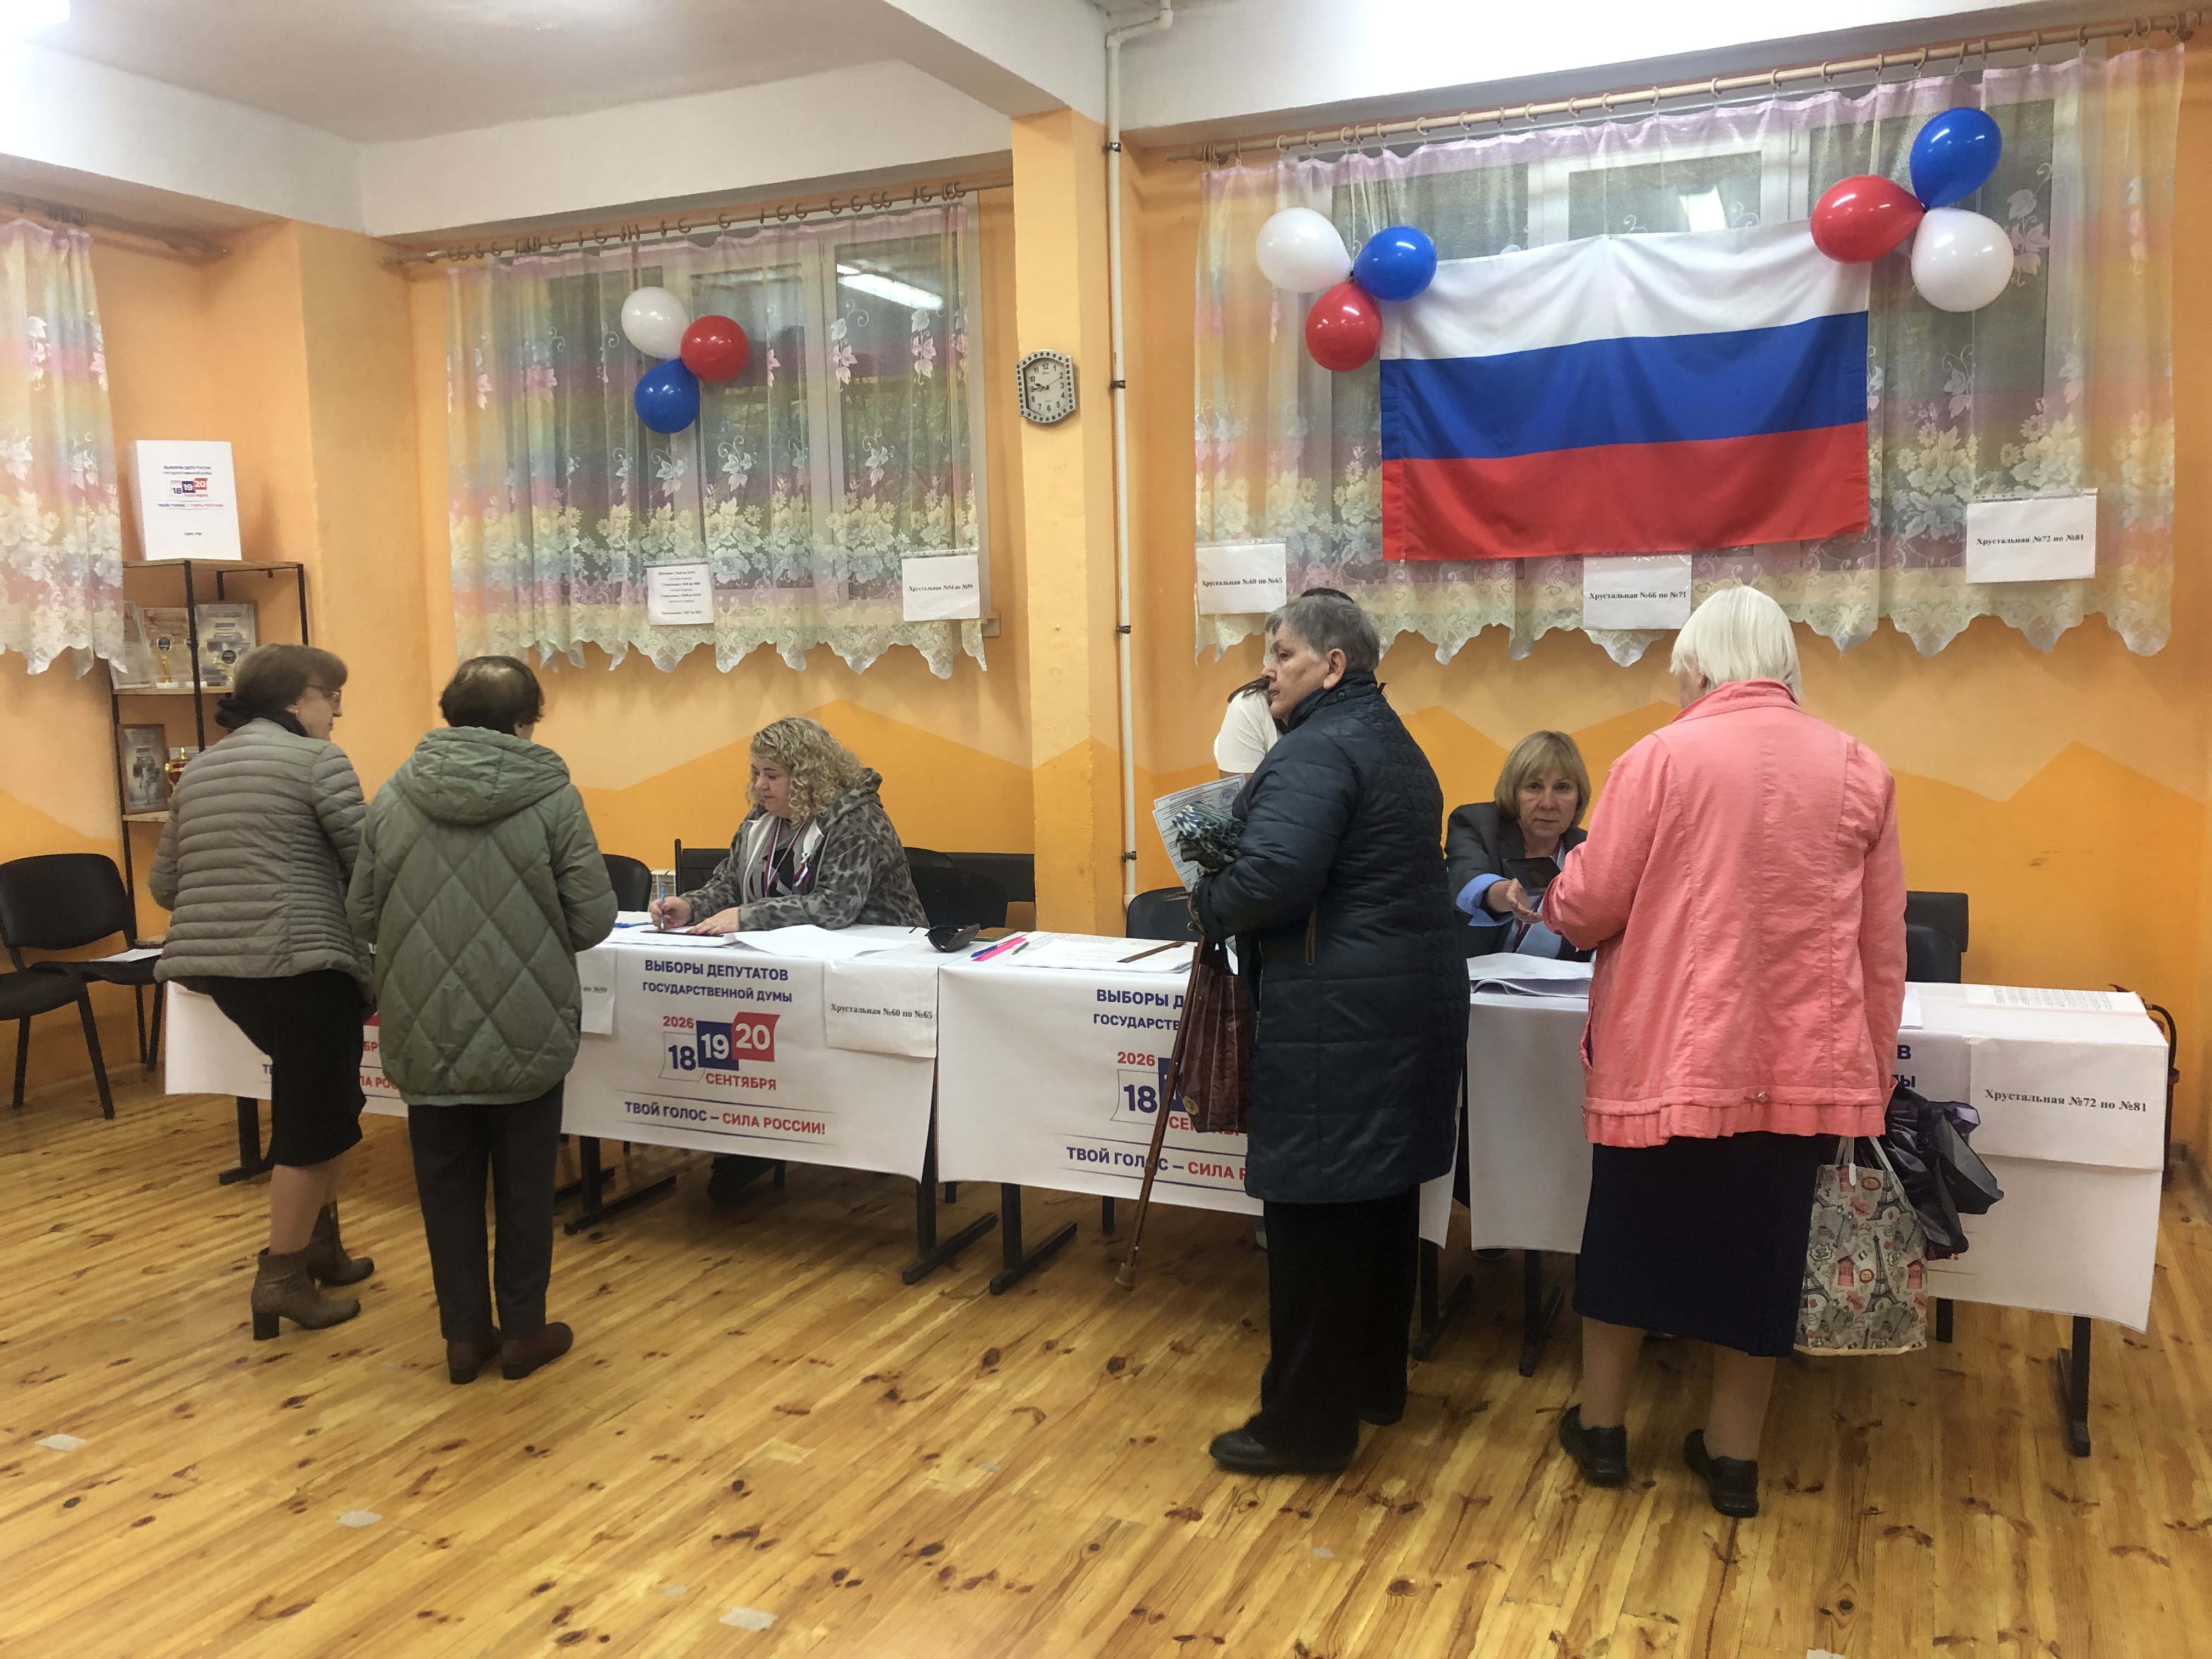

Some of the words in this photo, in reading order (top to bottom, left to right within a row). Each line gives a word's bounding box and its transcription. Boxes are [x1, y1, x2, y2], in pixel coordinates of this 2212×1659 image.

[1976, 538, 2030, 547] Хрустальная
[1589, 592, 1638, 601] Хрустальная
[645, 960, 704, 975] ВЫБОРЫ
[707, 964, 788, 981] ДЕПУТАТОВ
[642, 981, 754, 1000] ГОСУДАРСТВЕННОЙ
[756, 990, 792, 1002] ДУМЫ
[1097, 989, 1169, 1007] ВЫБОРЫ
[831, 1003, 881, 1015] Хрустальная
[883, 1008, 900, 1017] №60
[915, 1010, 933, 1019] №65
[663, 1015, 694, 1029] 2026
[1093, 1013, 1180, 1031] ГОСУДАРСТВ
[668, 1045, 696, 1071] 18
[701, 1033, 729, 1059] 19
[735, 1023, 771, 1050] 20
[1117, 1051, 1155, 1066] 2026
[706, 1073, 777, 1091] СЕНТЯБРЯ
[1124, 1084, 1158, 1113] 18
[1985, 1088, 2065, 1104] Хрустальная
[2068, 1096, 2096, 1108] №72
[2118, 1100, 2147, 1112] №81
[625, 1101, 659, 1116] ТВОЙ
[663, 1105, 708, 1121] ГОЛОС
[722, 1113, 760, 1128] СИЛА
[763, 1117, 826, 1135] РОССИИ!
[1066, 1146, 1110, 1164] ТВОЙ
[1114, 1152, 1169, 1170] ГОЛС
[1188, 1161, 1235, 1180] СИЛА
